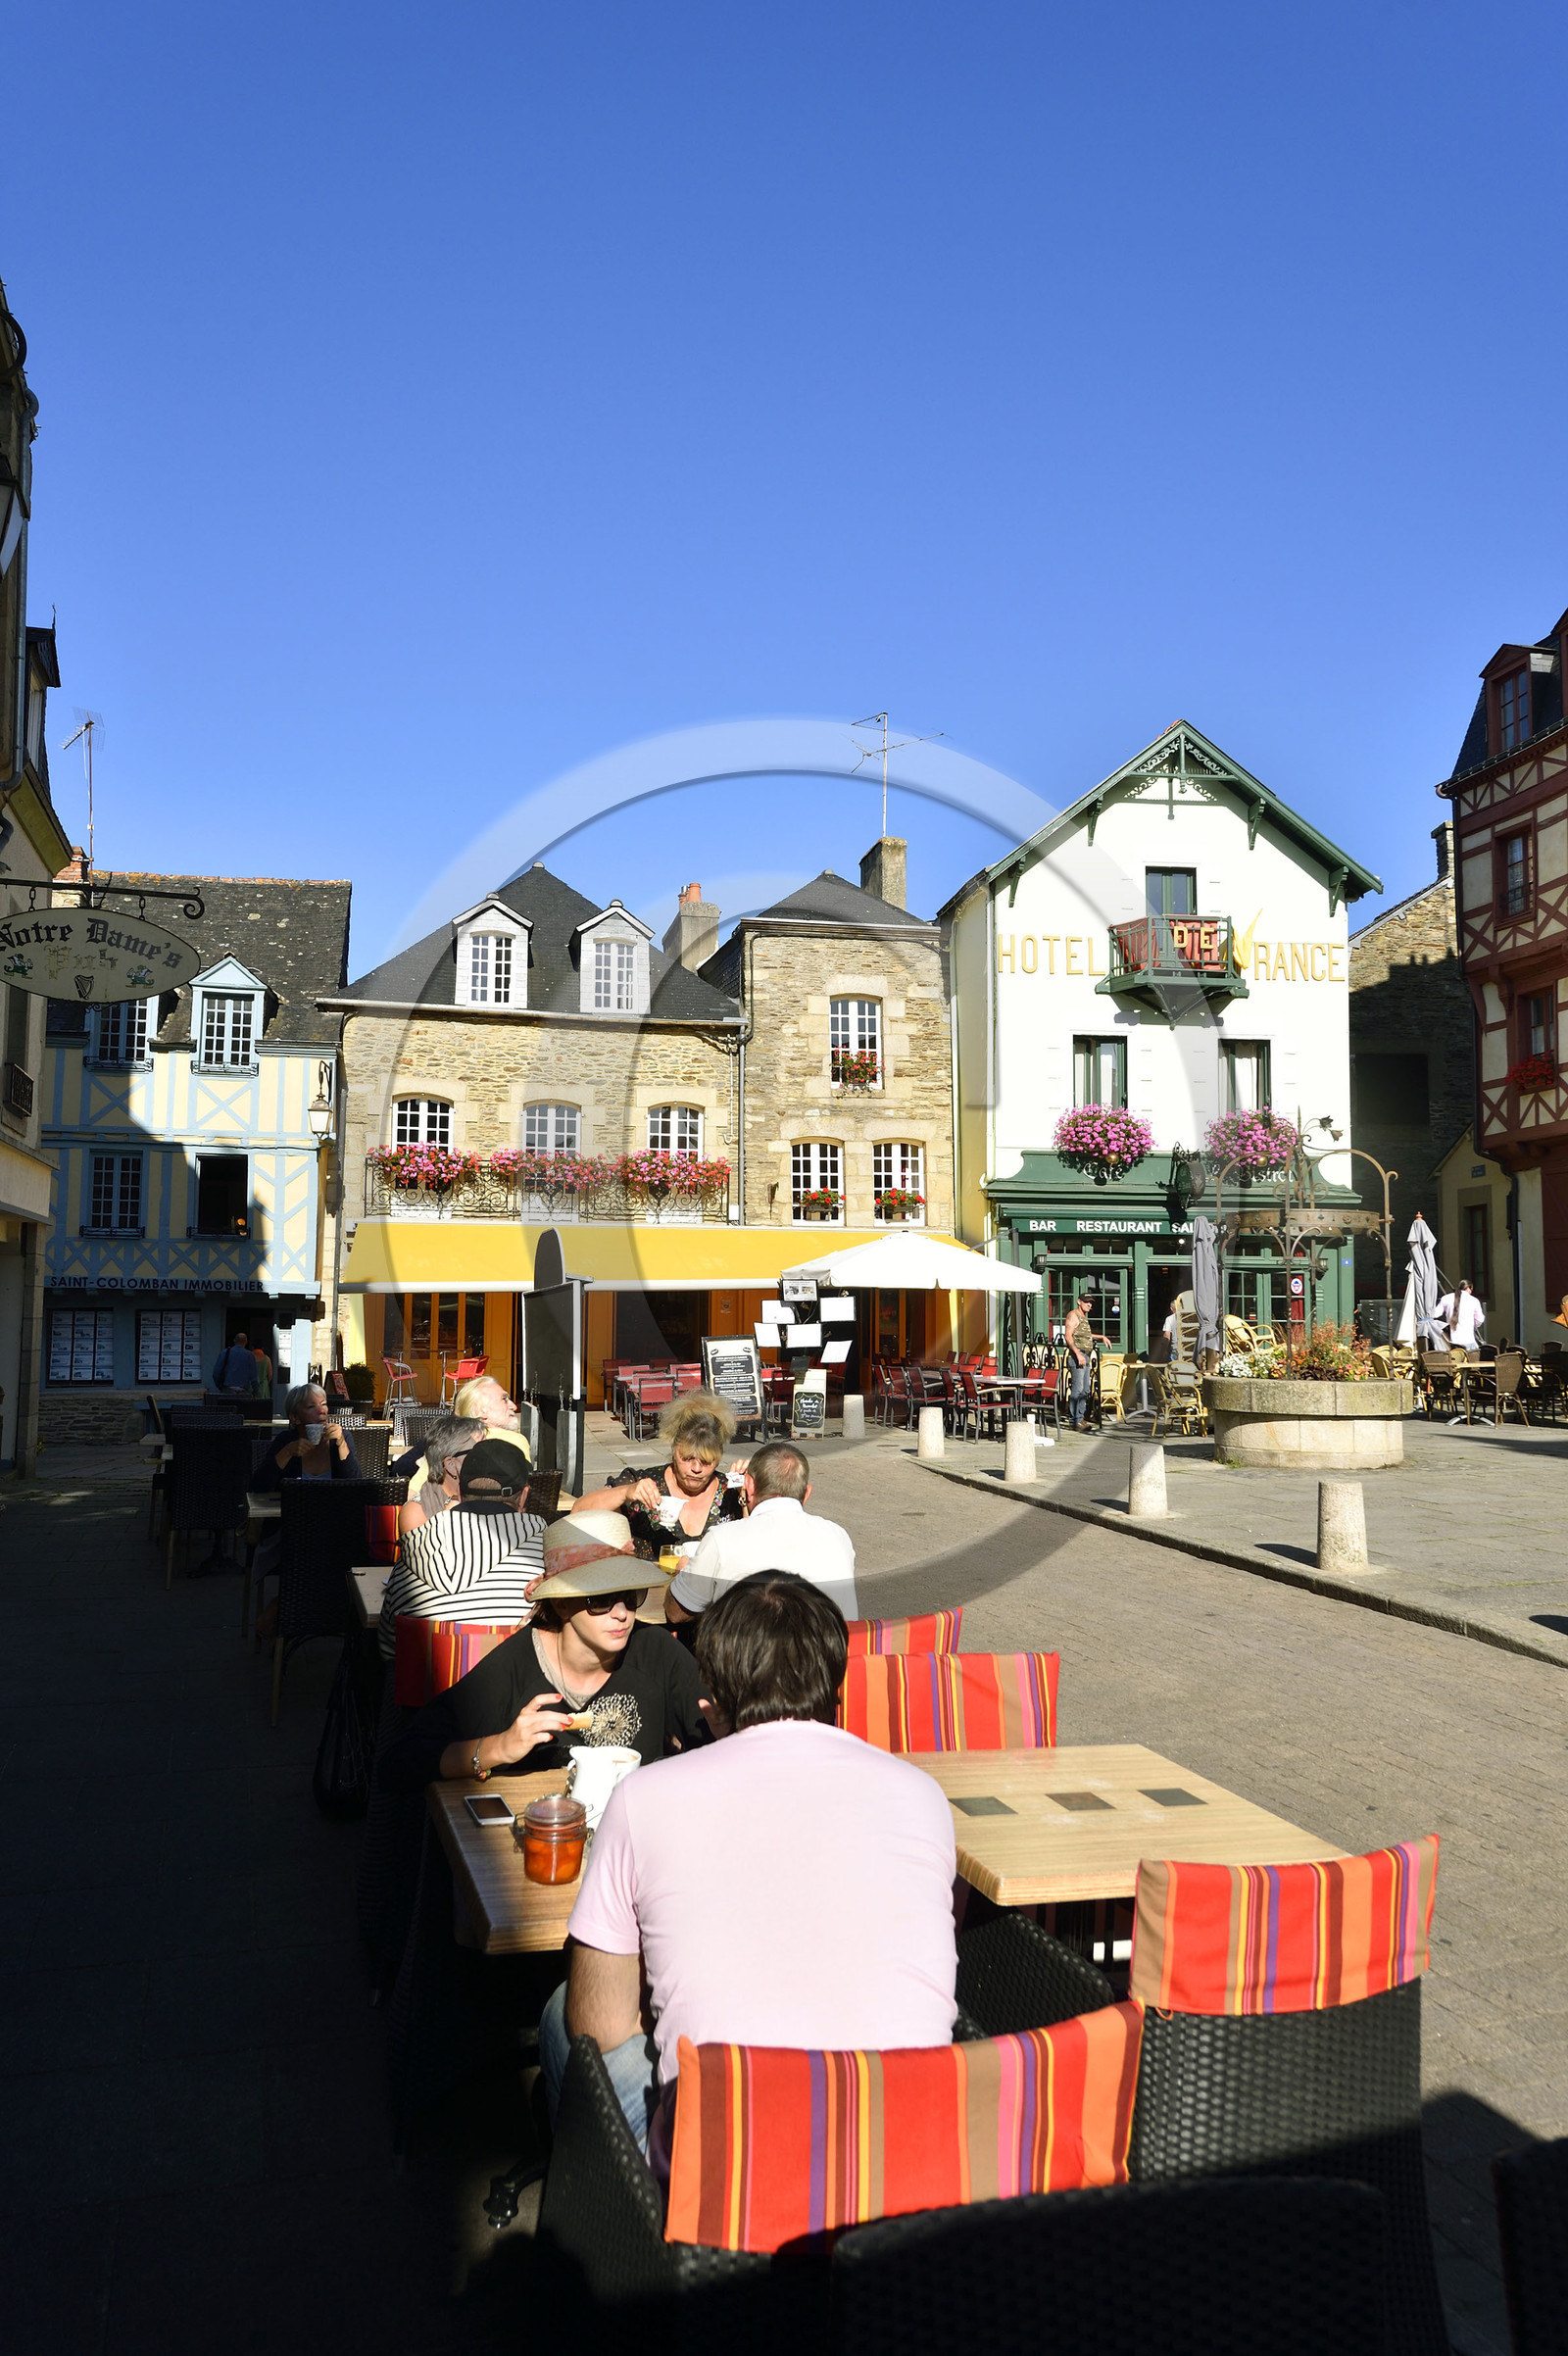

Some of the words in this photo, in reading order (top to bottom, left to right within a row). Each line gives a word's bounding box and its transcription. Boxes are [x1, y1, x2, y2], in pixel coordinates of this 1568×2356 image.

[0, 921, 74, 953] Notre
[86, 917, 183, 968] Dame's
[998, 933, 1106, 976] HOTEL
[1173, 926, 1215, 949] DE
[1253, 942, 1346, 982] RANCE
[1029, 1220, 1057, 1232] BAR
[1076, 1221, 1163, 1233] RESTAURANT
[50, 1276, 179, 1291] SAINT-COLOMBAN
[183, 1279, 264, 1292] IMMOBILIER
